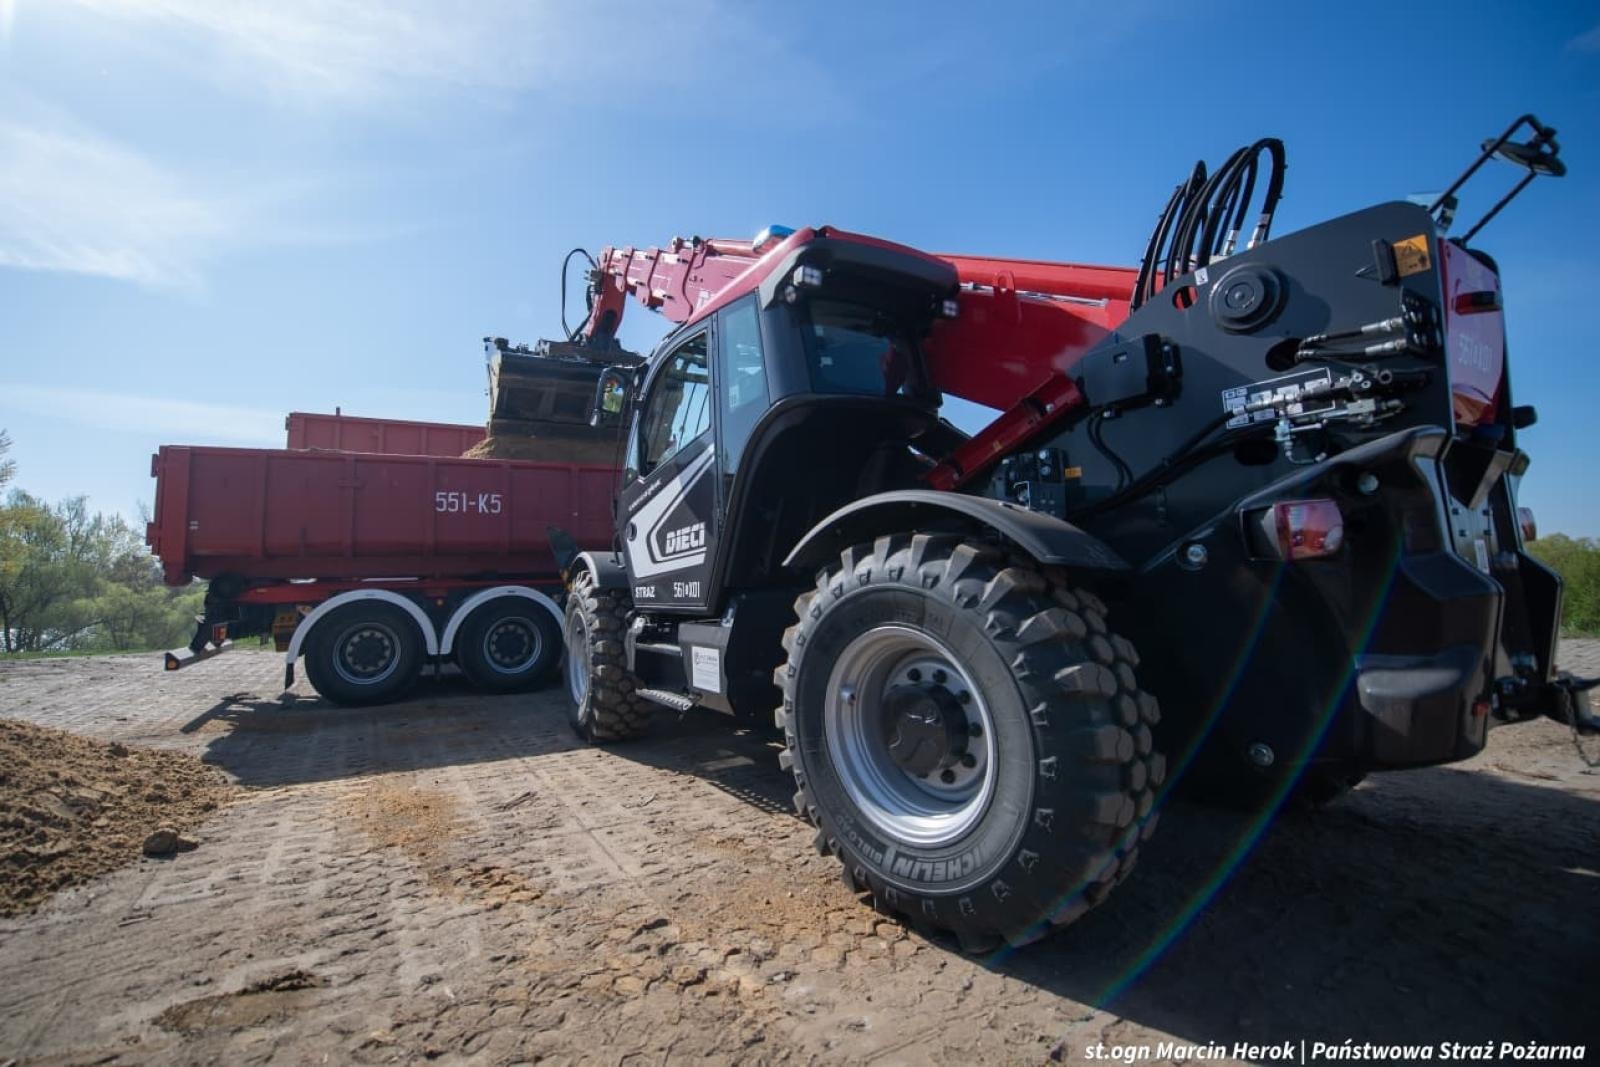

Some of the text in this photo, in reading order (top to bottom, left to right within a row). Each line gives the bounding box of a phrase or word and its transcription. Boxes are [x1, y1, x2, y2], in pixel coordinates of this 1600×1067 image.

[435, 491, 502, 513] 551-K5
[665, 521, 706, 555] DIECI
[890, 841, 995, 882] ICHELIN
